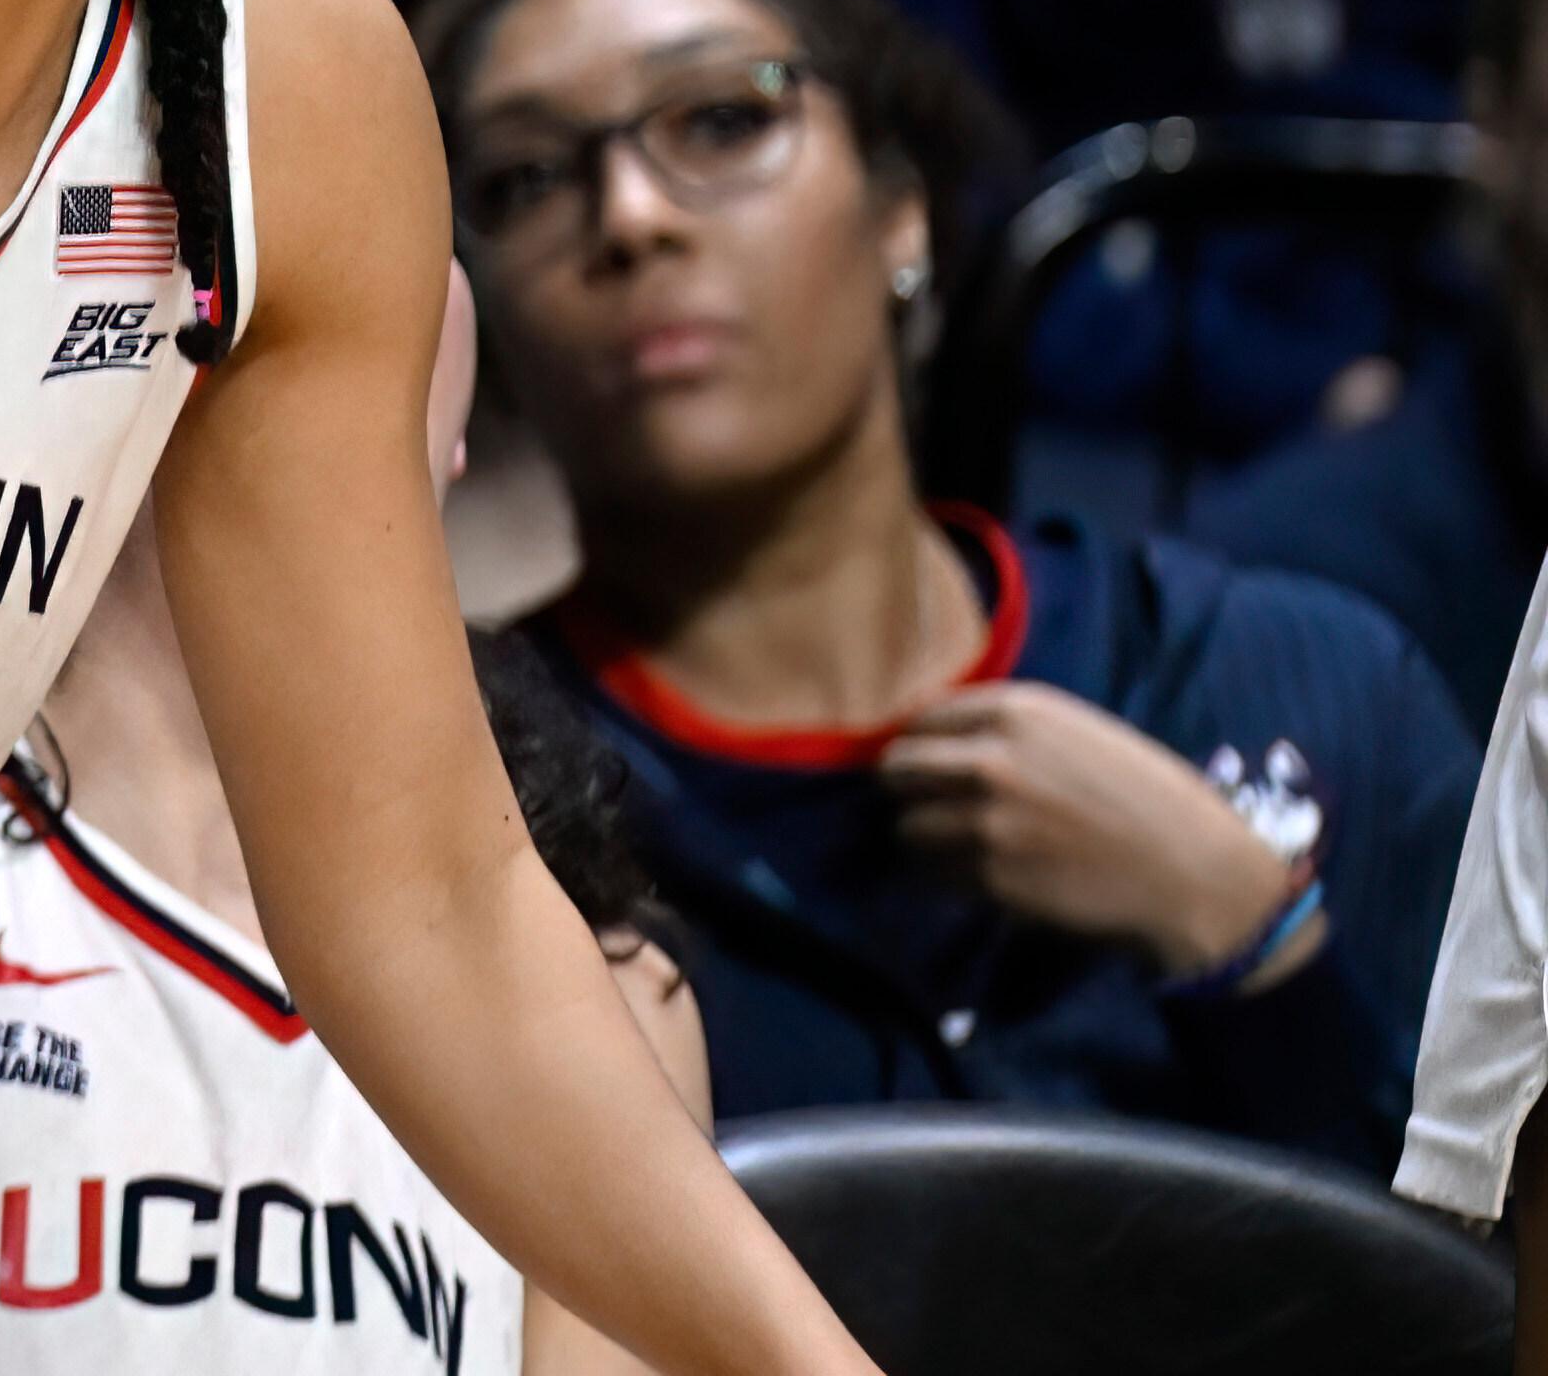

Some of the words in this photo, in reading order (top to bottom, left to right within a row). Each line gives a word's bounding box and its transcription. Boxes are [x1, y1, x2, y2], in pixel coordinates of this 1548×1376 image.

[67, 299, 156, 332] BIG
[52, 331, 169, 363] EAST
[36, 1026, 82, 1062] THE
